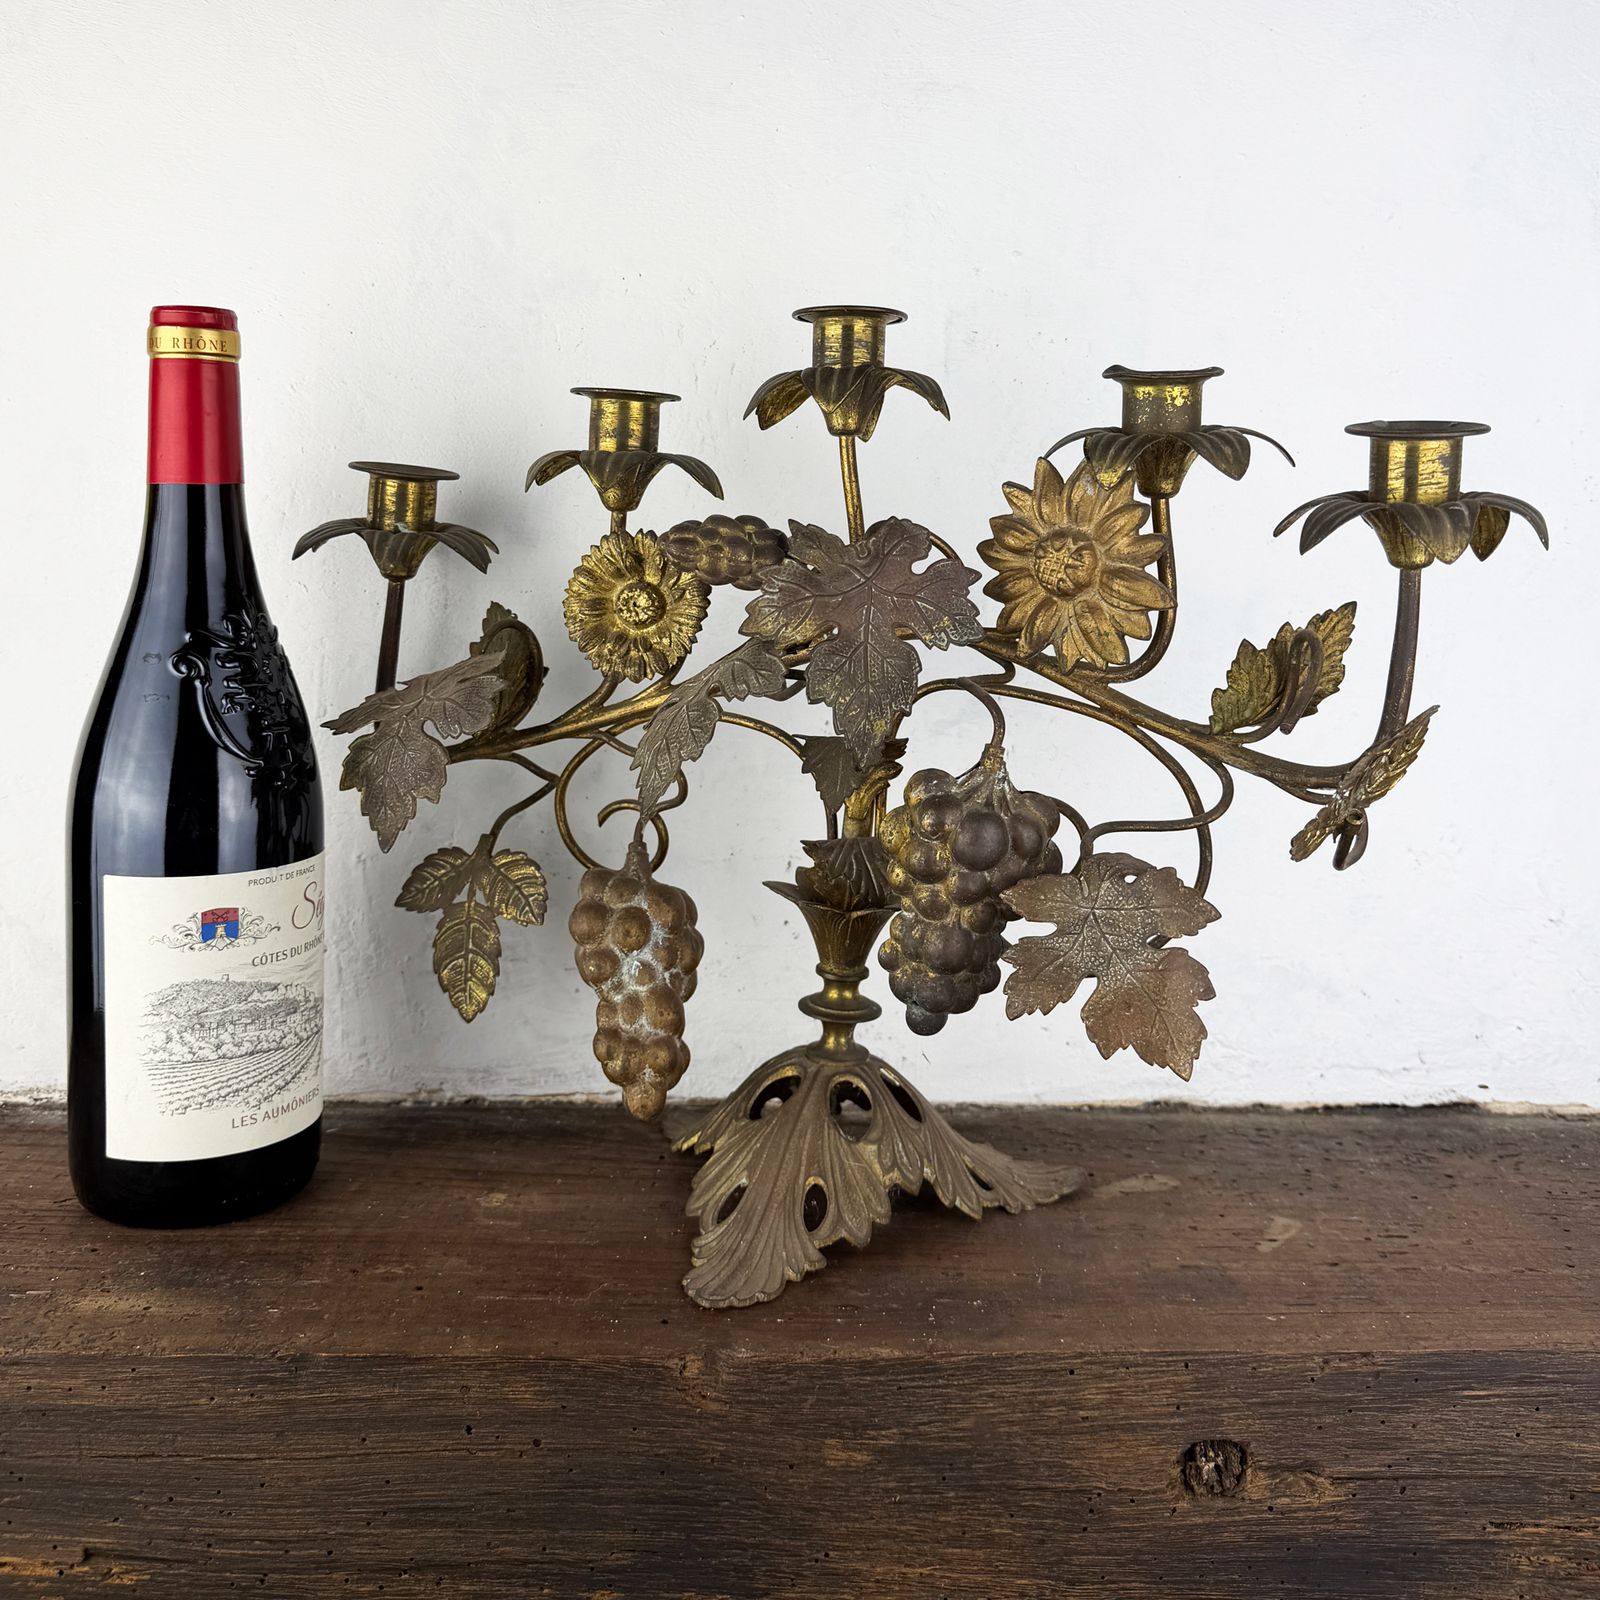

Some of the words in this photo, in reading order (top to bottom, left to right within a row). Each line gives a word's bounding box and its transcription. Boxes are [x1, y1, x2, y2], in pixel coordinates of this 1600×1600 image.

[172, 335, 228, 353] RHÔNE
[248, 873, 283, 886] PRODUT
[285, 871, 295, 880] DE
[295, 864, 316, 877] FRANCE
[252, 949, 288, 967] CÔTES
[290, 945, 303, 958] DU
[231, 1113, 258, 1129] LES
[262, 1087, 320, 1122] AUMÔNIERS
